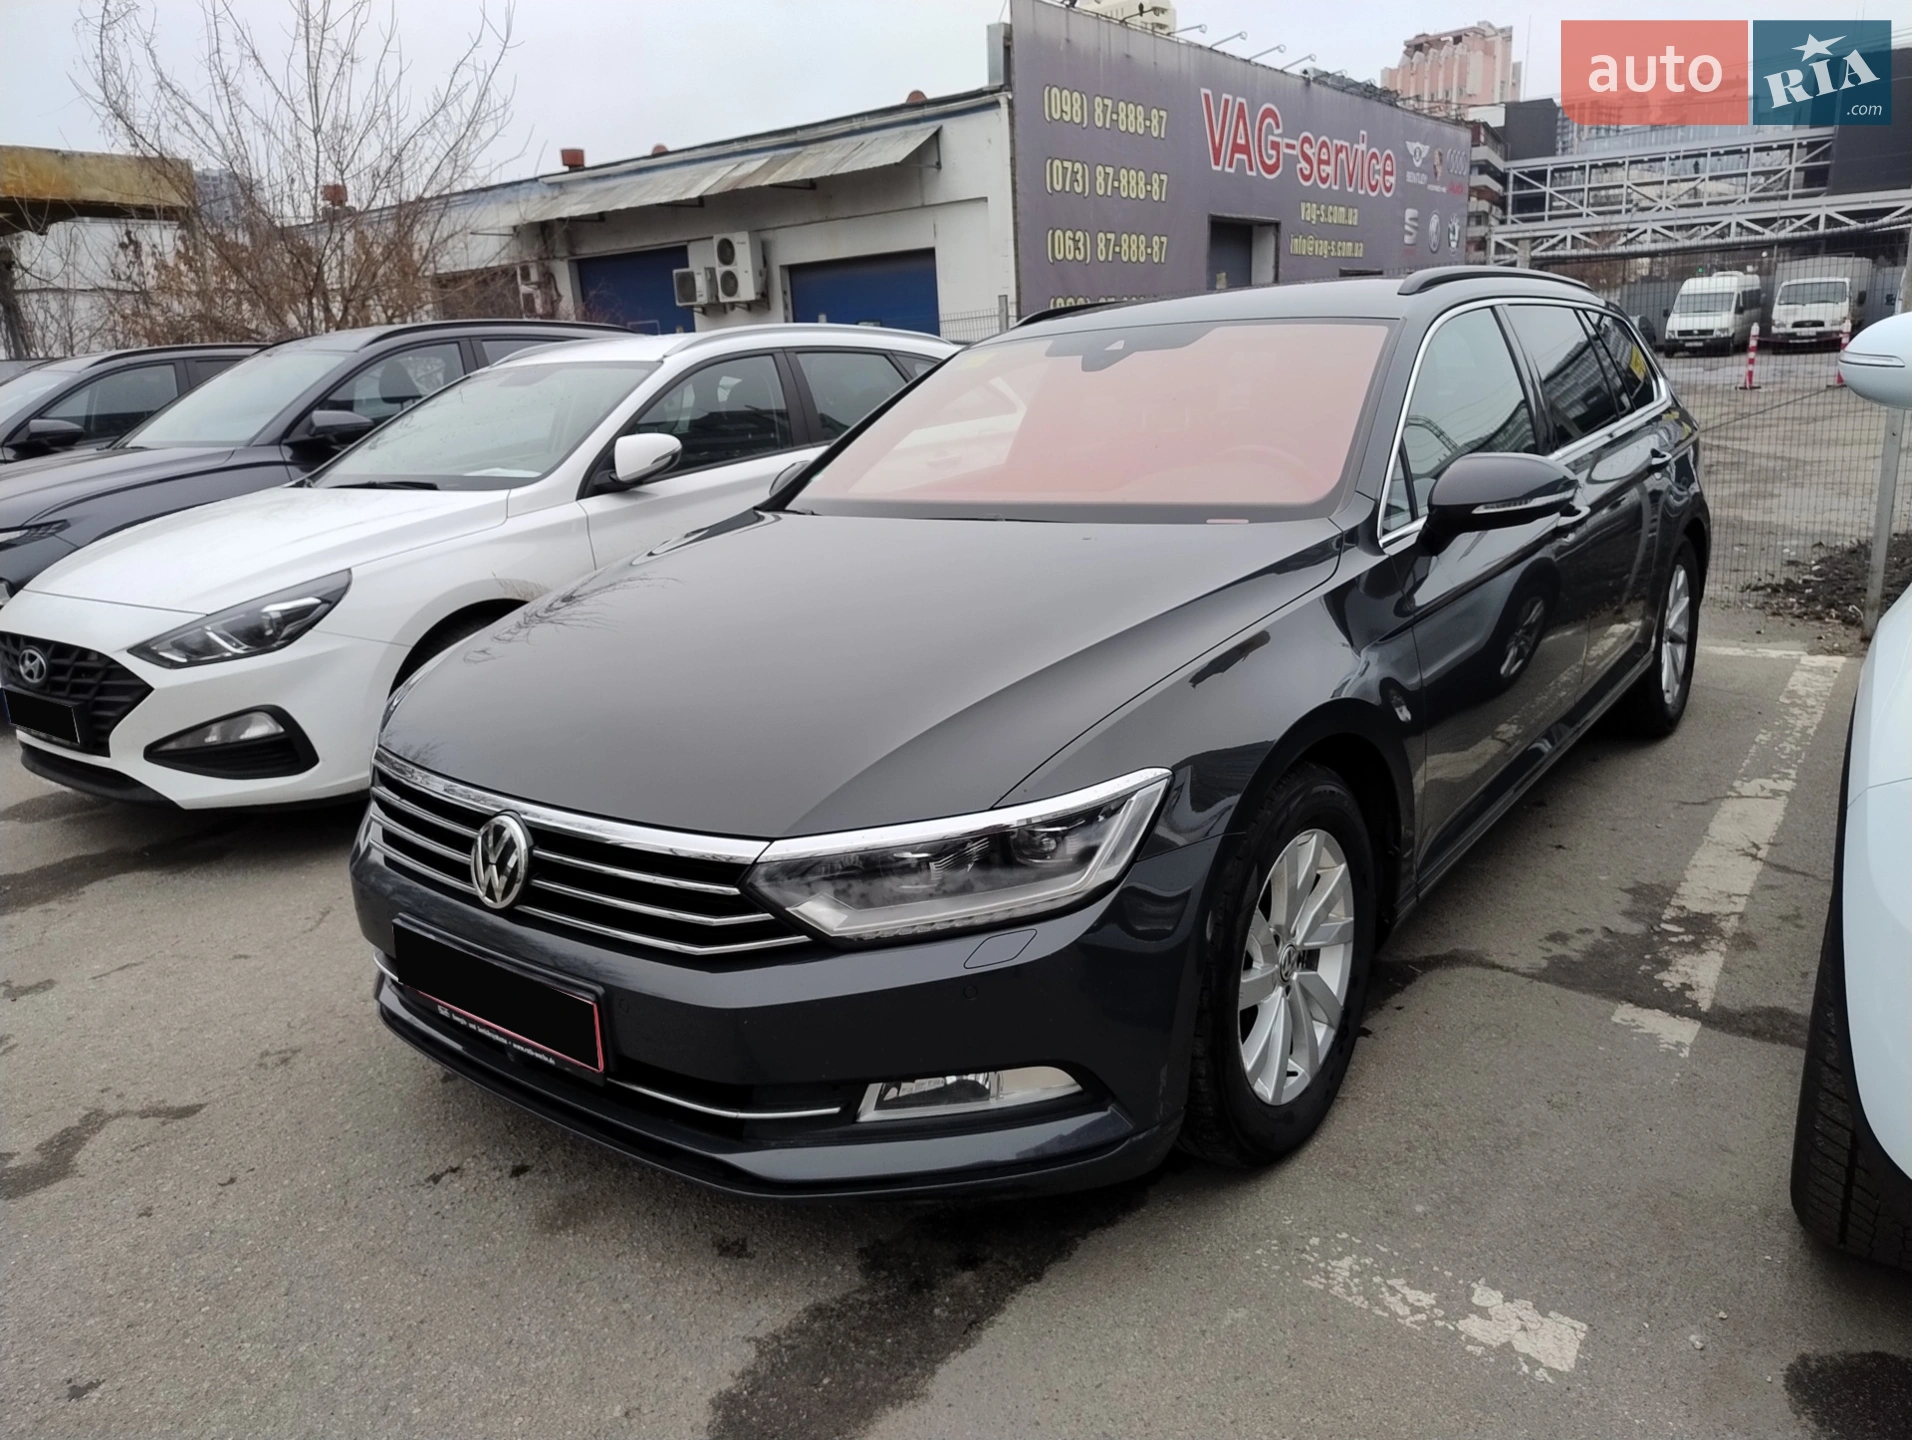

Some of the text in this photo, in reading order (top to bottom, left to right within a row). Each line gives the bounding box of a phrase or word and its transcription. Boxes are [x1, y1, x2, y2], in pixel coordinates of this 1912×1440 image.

[1044, 86, 1168, 139] (098) 87-888-87
[1200, 87, 1396, 198] VAG-service
[1046, 158, 1168, 202] (073) 87-888-87
[1300, 200, 1359, 226] vag-s.com.ua
[1047, 229, 1168, 264] (063) 87-888-87
[1290, 233, 1364, 259] info@vag-s.com.ua
